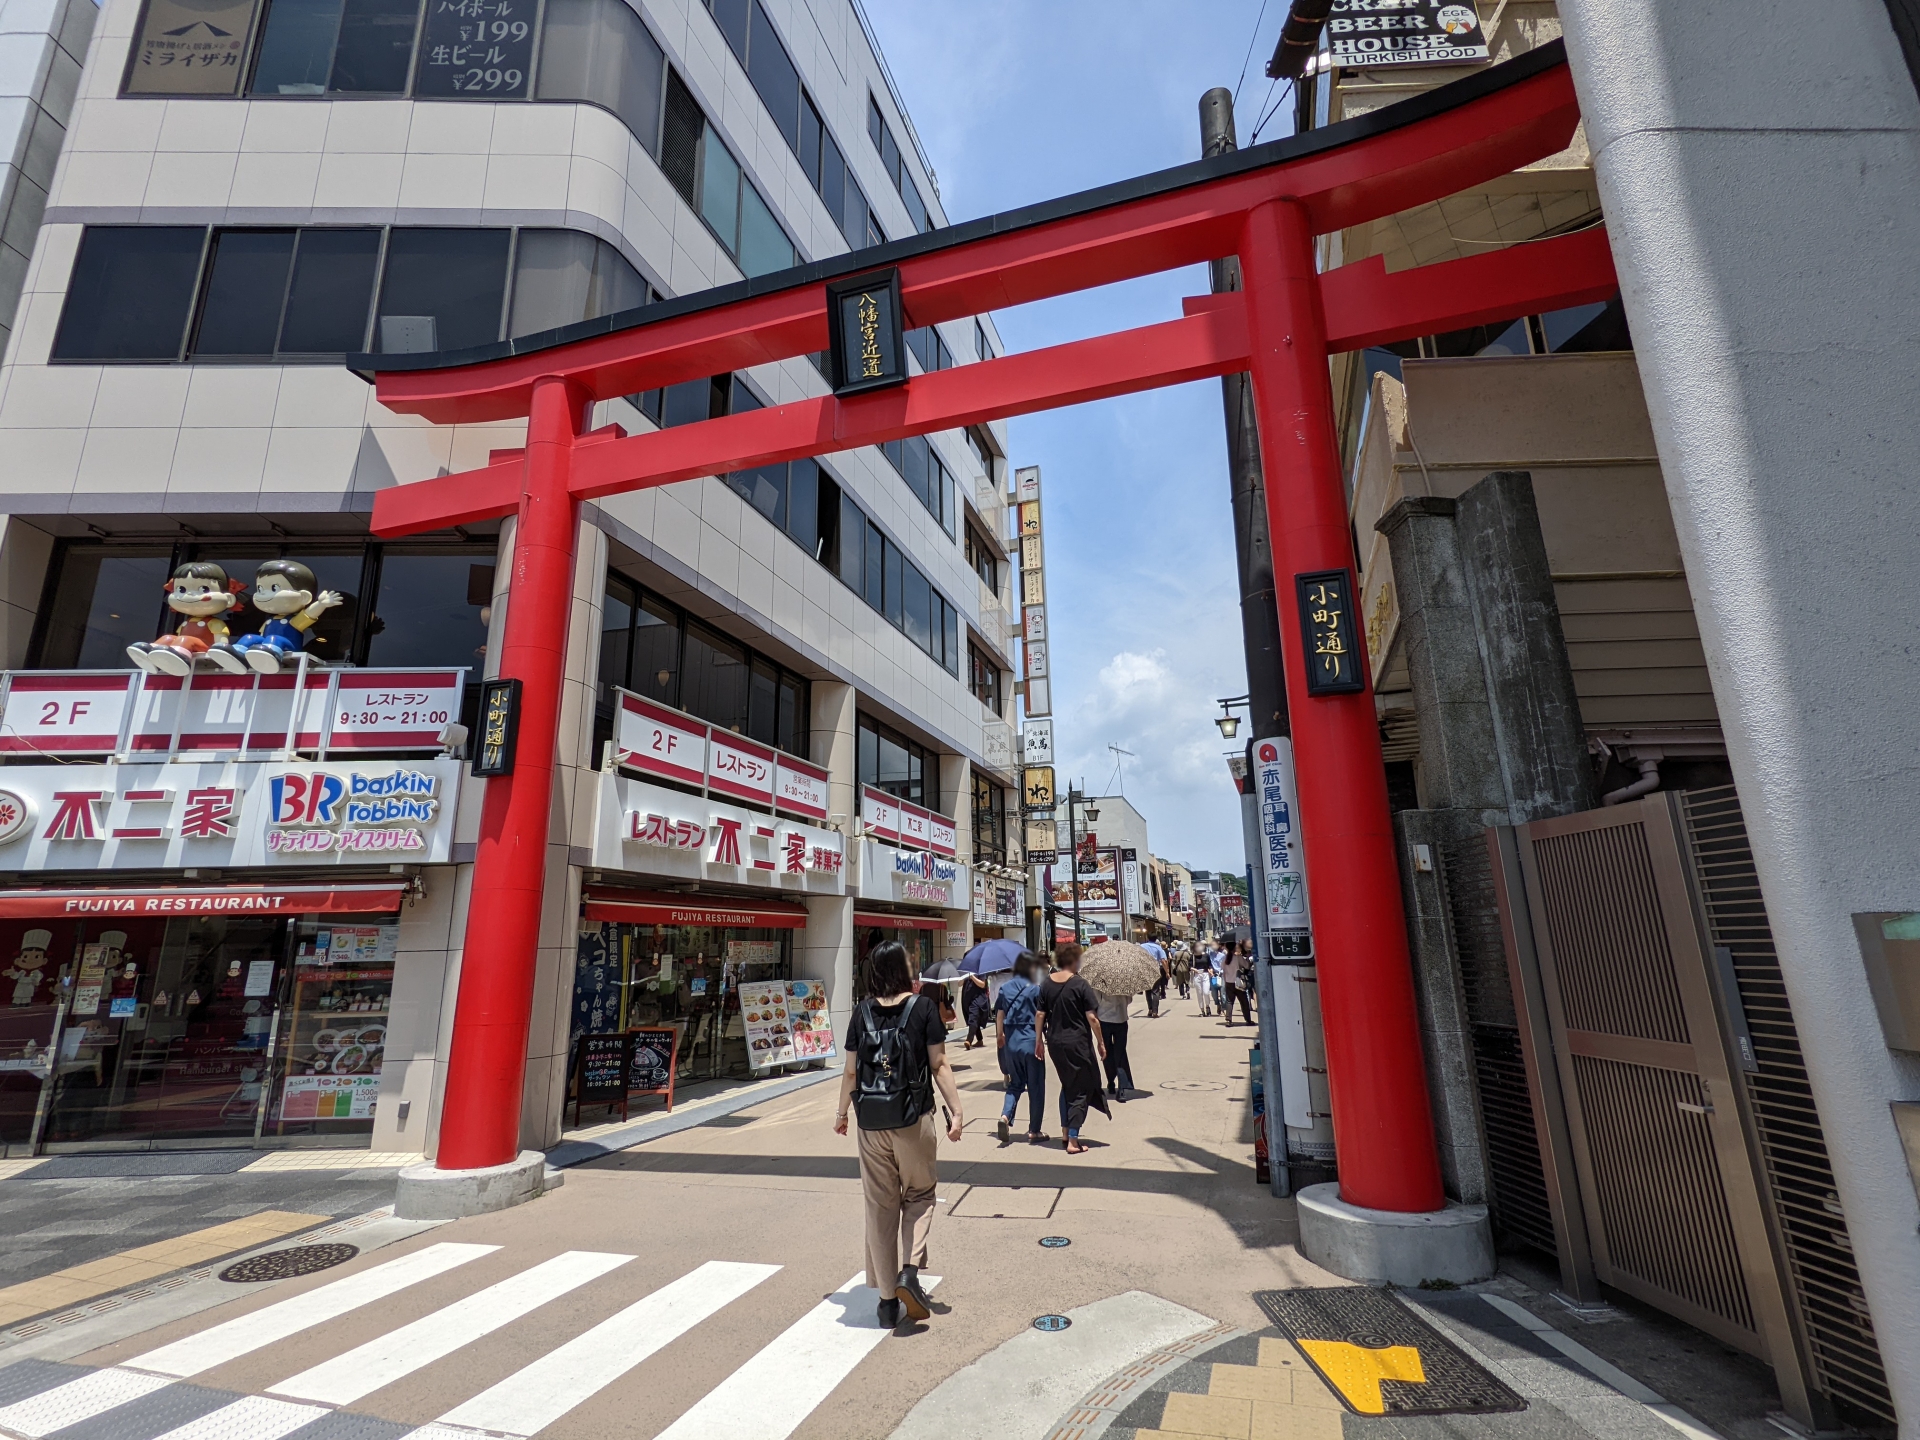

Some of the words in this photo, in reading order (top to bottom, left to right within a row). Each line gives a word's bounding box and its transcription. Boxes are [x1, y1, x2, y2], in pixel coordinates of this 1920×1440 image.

[1442, 9, 1470, 17] EGE
[1330, 15, 1429, 33] BEER
[1333, 34, 1453, 54] HOUSE
[142, 50, 238, 68] ミライザカ
[429, 45, 507, 65] 生ビール
[1342, 51, 1421, 65] TURKISH
[1426, 48, 1477, 60] FOOD
[858, 293, 884, 378] 八幡宮近道
[1309, 584, 1348, 680] 小町通り
[365, 693, 429, 706] レストラン
[486, 690, 508, 765] 小町通り
[716, 750, 767, 782] レストラン
[270, 772, 344, 824] BR
[1027, 784, 1049, 802] わん
[43, 787, 236, 839] 不二家
[908, 817, 922, 833] 不二家
[933, 826, 953, 843] レストラン
[269, 831, 333, 850] サーティワン
[337, 829, 420, 848] アイスクリーム
[631, 812, 707, 849] レストラン
[714, 817, 806, 874] 不二家
[812, 846, 843, 874] 洋菓子
[65, 899, 136, 912] FUJIYA
[145, 896, 285, 911] RESTAURANT
[672, 911, 702, 922] FUJIYA
[705, 913, 756, 924] RESTAURANT
[1280, 944, 1298, 953] 1-5
[591, 931, 607, 1035] ペコちゃん焼
